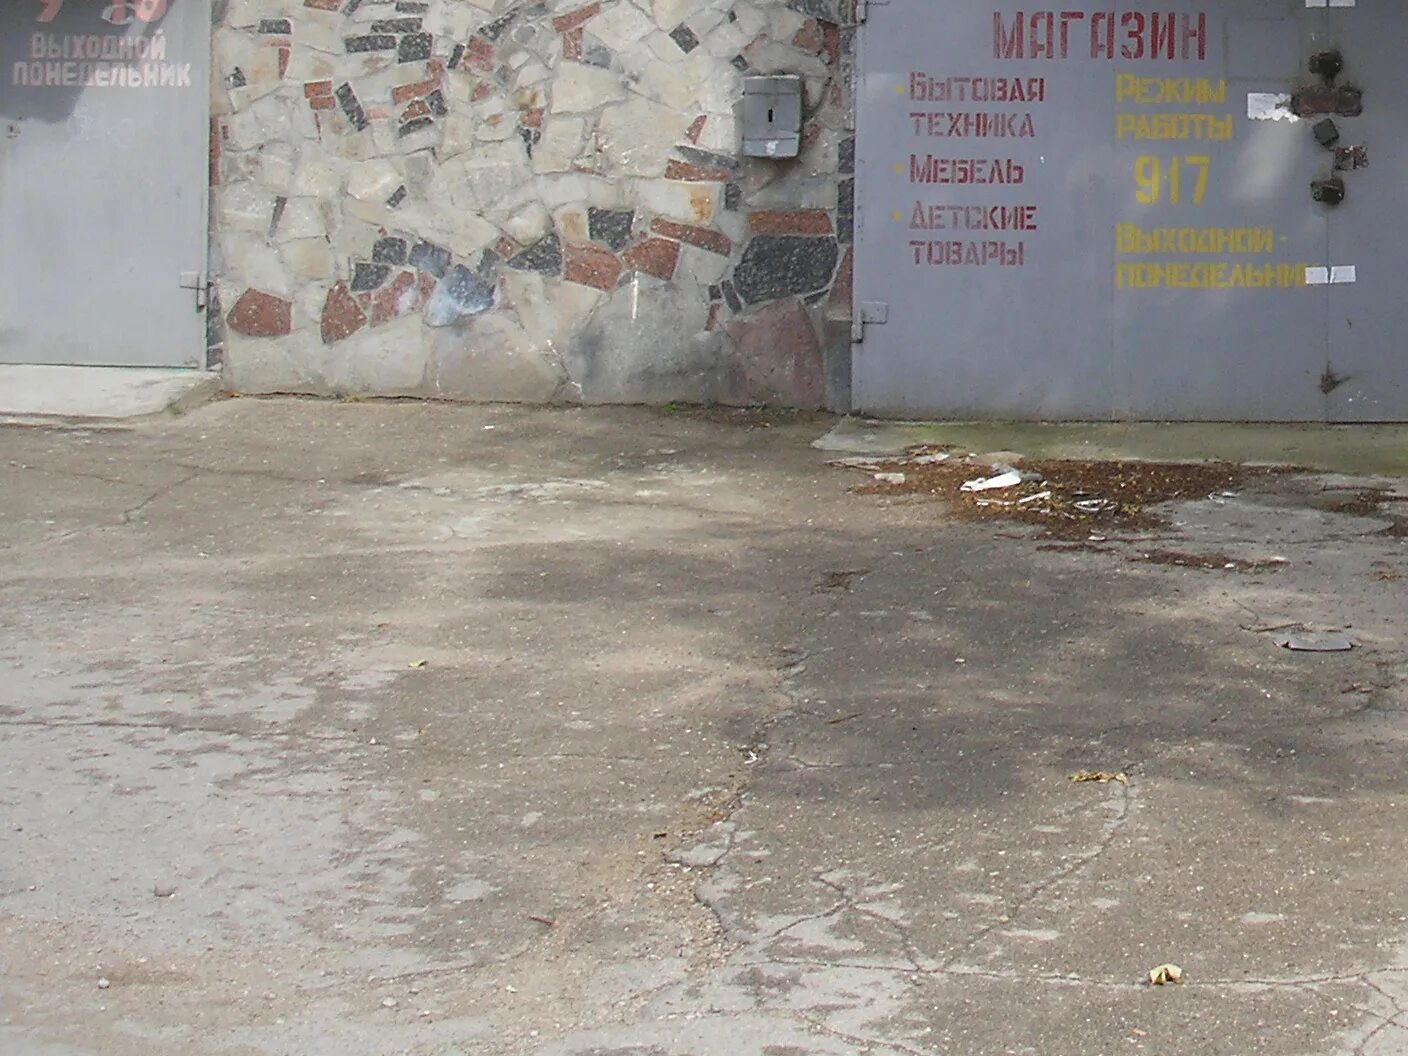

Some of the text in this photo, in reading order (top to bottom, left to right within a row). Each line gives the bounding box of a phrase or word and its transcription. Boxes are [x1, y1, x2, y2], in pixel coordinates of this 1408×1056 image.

[31, 29, 166, 60] ВЫХОДНОЙ
[992, 10, 1206, 60] МАГАЗИН
[12, 61, 192, 88] ПОНЕДЕЛЬНИК
[909, 112, 1035, 138] ТЕХНИКА
[1116, 113, 1233, 140] РАБОТЫ
[909, 240, 1024, 265] ТОВАРЫ
